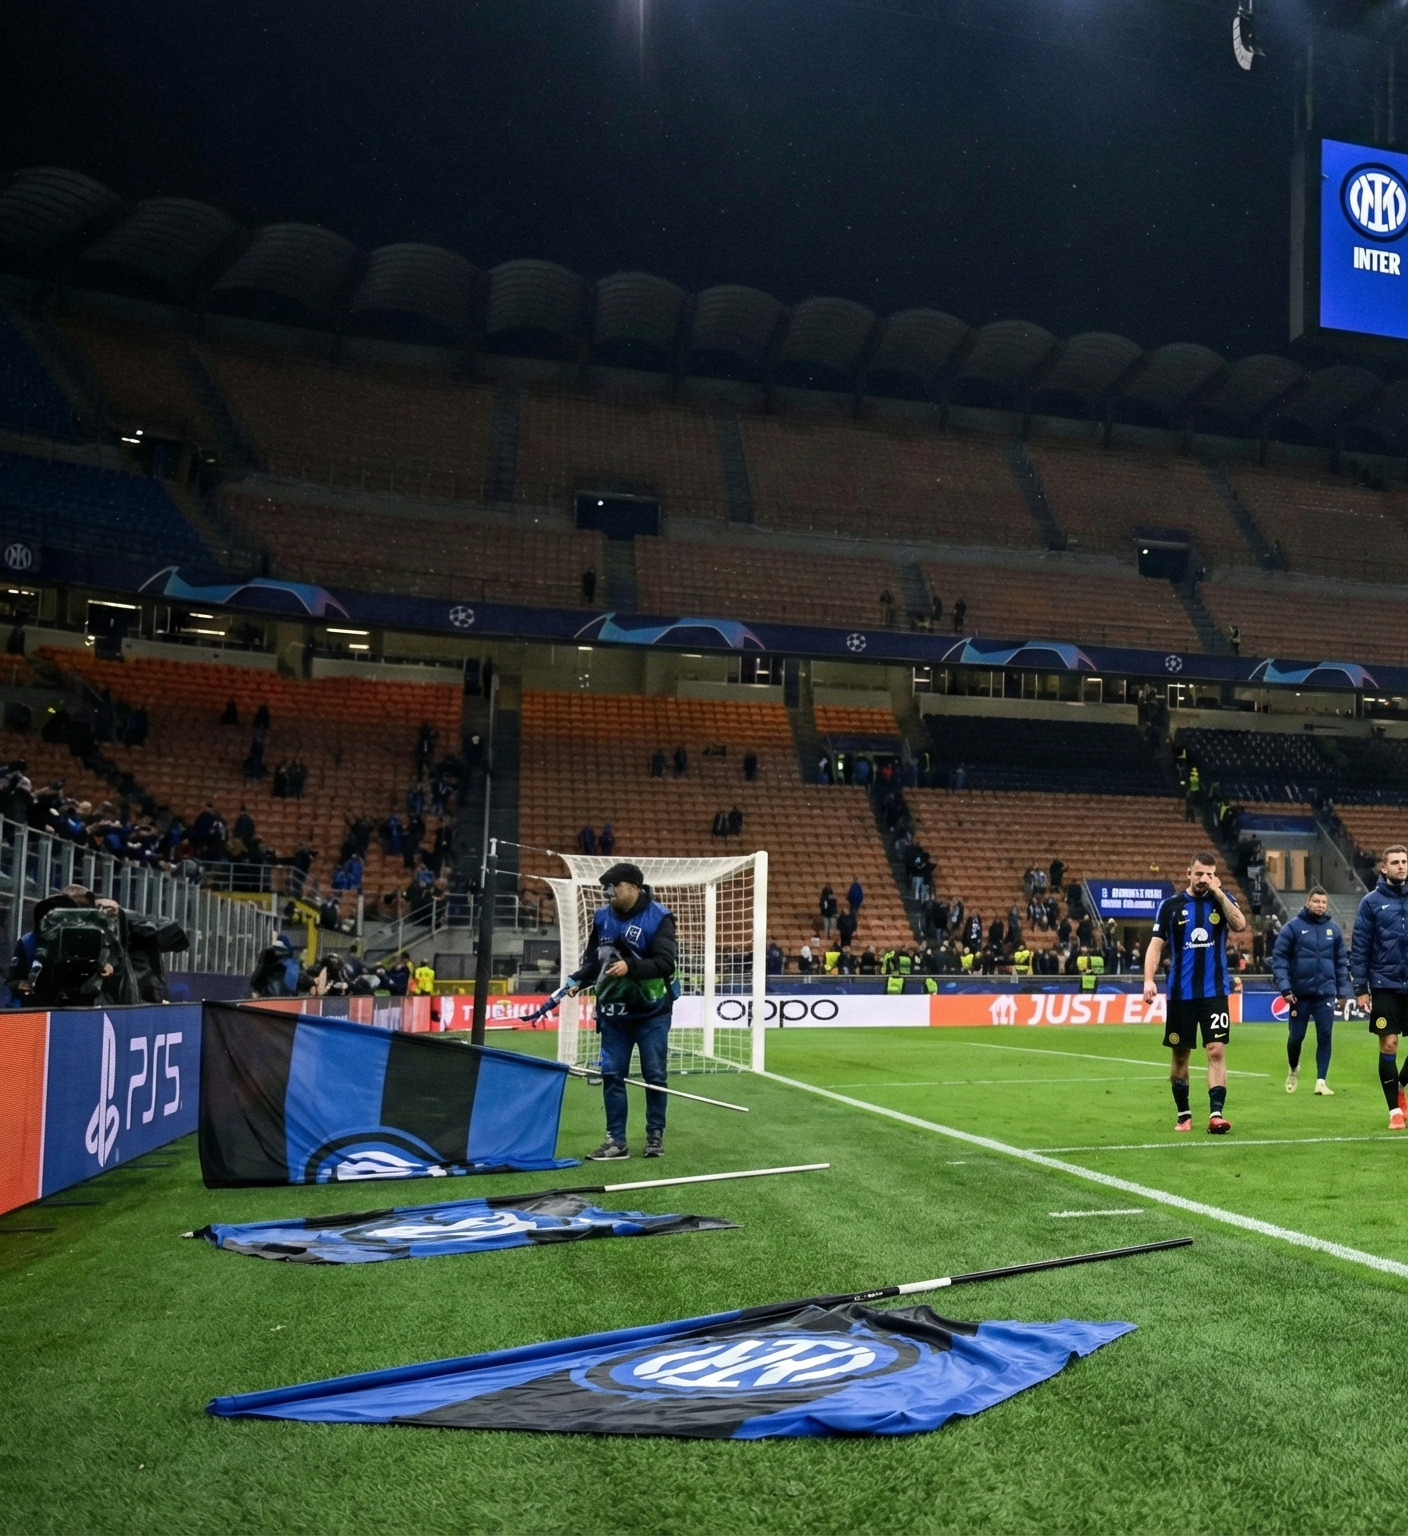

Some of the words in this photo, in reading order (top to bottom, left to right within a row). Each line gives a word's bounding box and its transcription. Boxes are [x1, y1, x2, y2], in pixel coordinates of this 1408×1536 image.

[1354, 247, 1400, 275] INTER
[717, 999, 839, 1028] oppo
[1027, 994, 1116, 1025] JUST
[1210, 1012, 1229, 1029] 20
[126, 1031, 183, 1130] PS5
